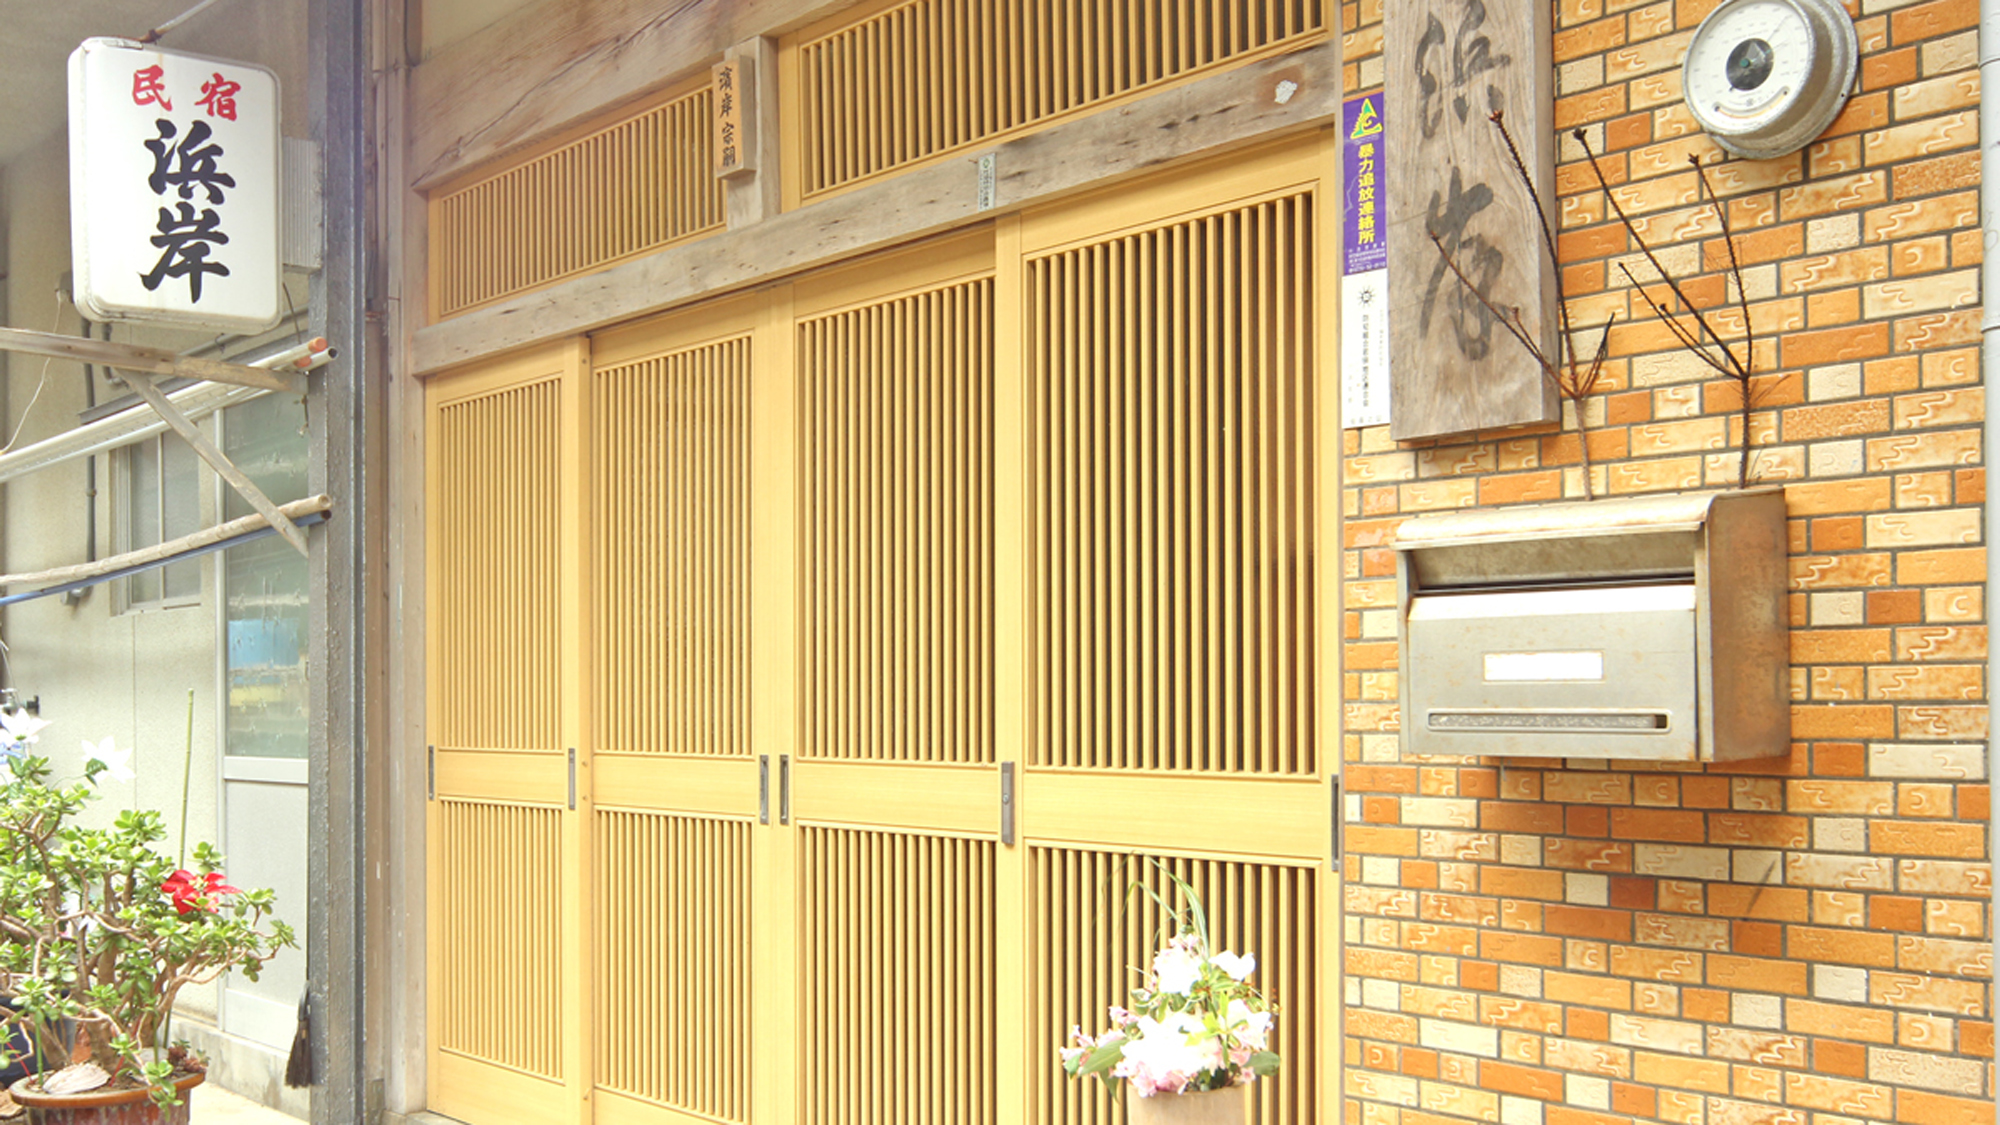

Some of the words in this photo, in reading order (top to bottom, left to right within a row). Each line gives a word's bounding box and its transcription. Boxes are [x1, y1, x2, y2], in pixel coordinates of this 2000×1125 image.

[132, 64, 241, 121] 民宿
[137, 118, 236, 303] 浜岸
[1358, 142, 1375, 244] 暴力追放連絡所
